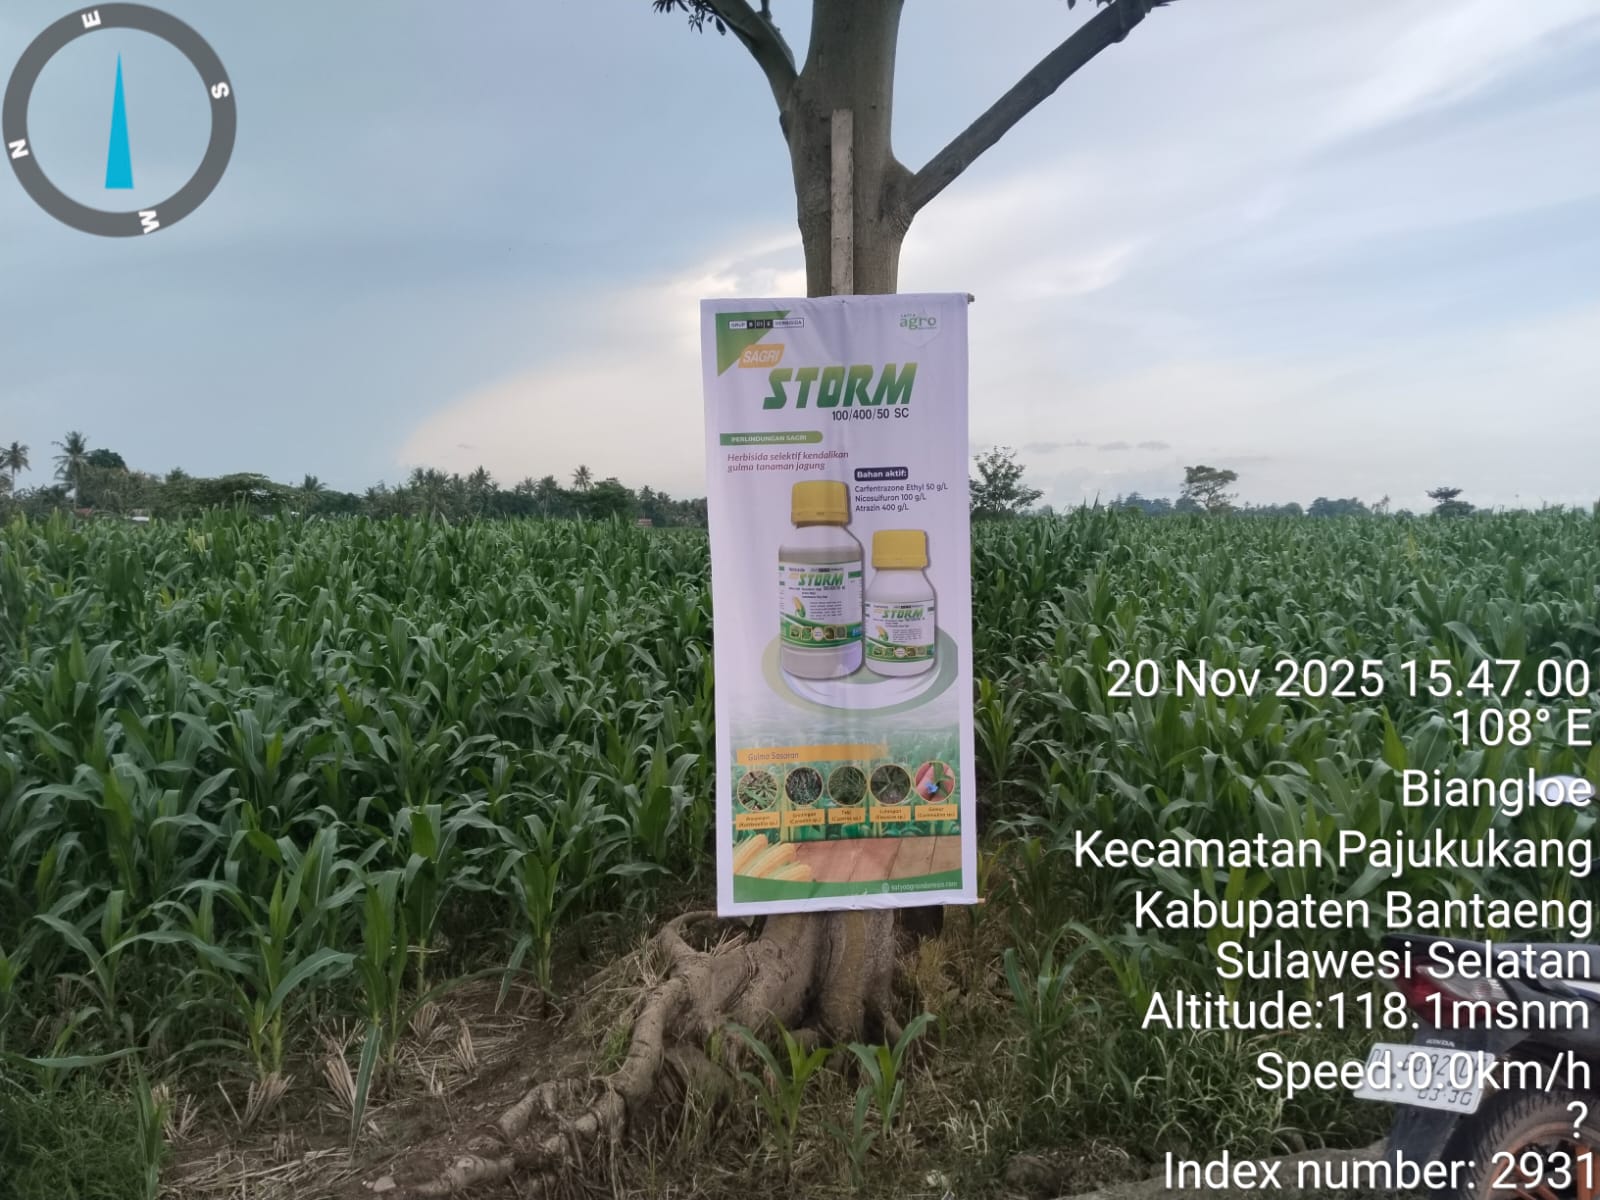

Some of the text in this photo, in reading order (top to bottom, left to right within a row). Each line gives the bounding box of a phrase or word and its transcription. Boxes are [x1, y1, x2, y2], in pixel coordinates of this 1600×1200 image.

[743, 350, 780, 363] SAGRI
[763, 363, 918, 409] STORM
[832, 407, 910, 421] 100/400/50 SC
[727, 451, 849, 461] Herbisida selektif kendalikan
[727, 462, 825, 473] gulma tanaman jagung
[885, 469, 907, 477] aktif:
[855, 485, 905, 493] Carfentrazone
[906, 483, 924, 492] Ethyl
[936, 482, 949, 491] g/L
[855, 494, 900, 502] Nicosulfuron
[914, 492, 927, 502] g/L
[855, 504, 880, 512] Atrazin
[897, 503, 909, 512] g/L
[798, 572, 844, 586] STORM
